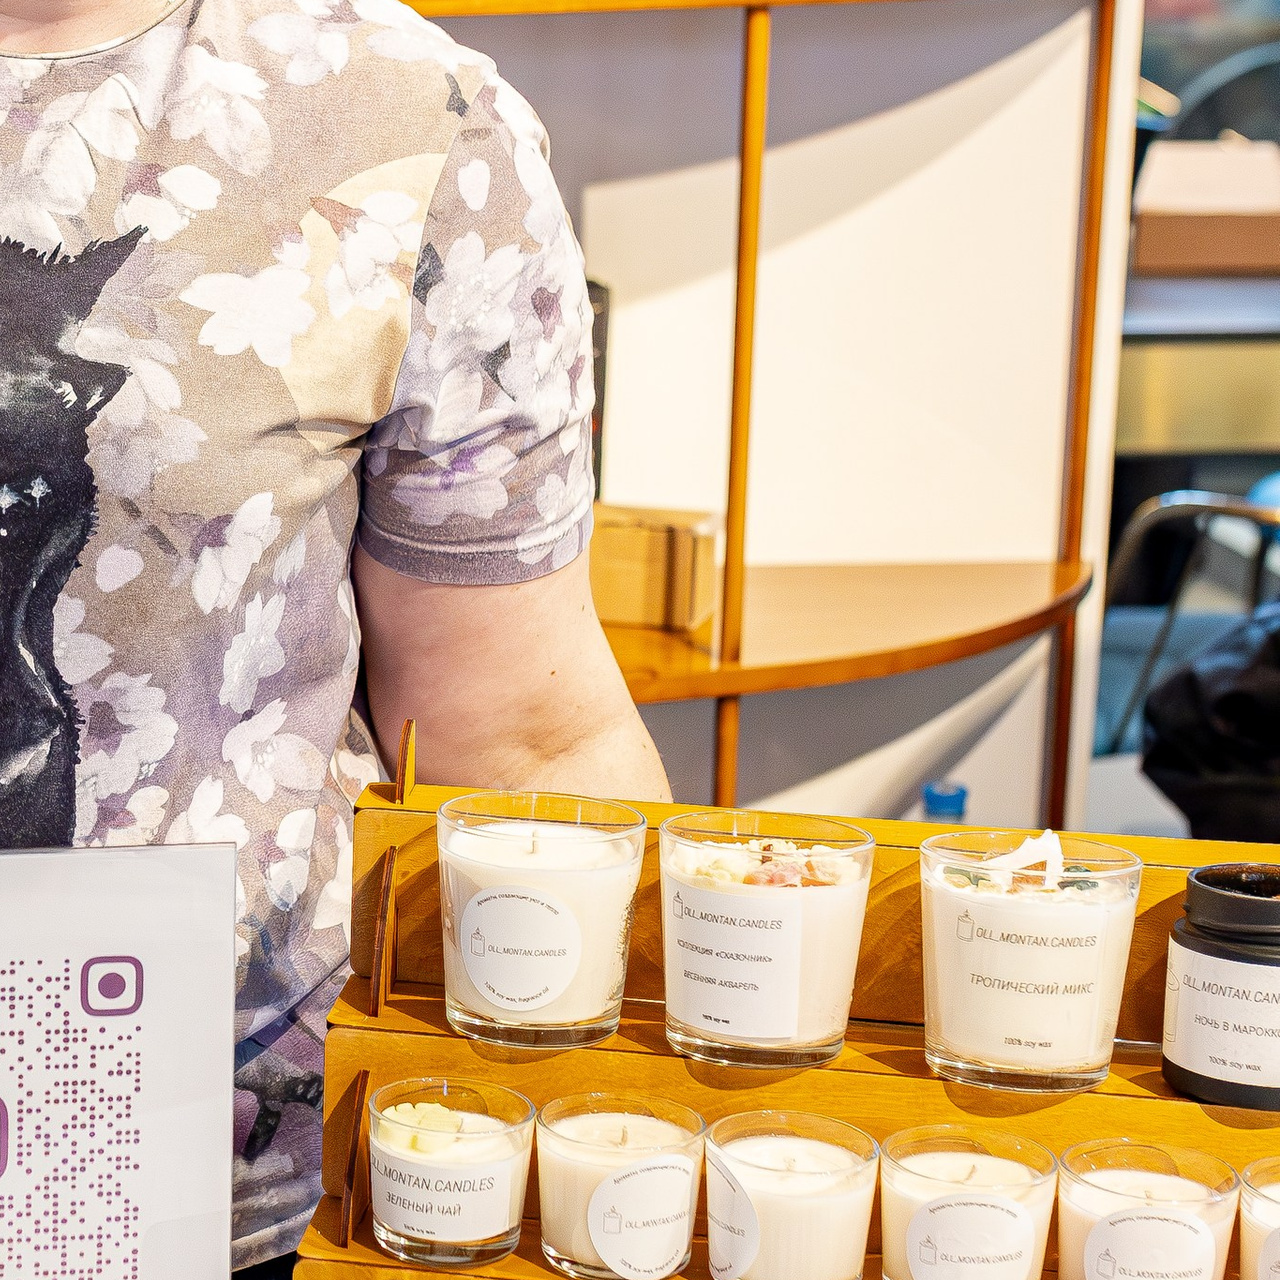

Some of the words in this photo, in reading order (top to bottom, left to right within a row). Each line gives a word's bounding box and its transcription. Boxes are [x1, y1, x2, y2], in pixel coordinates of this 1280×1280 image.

[684, 906, 782, 930] OLL_MONTAN.CANDLES
[976, 927, 1097, 948] OLL_MONTAN.CANDLES
[487, 944, 568, 958] OLL_MONTAN.CANDLES
[970, 972, 1059, 995] ТРОПИЧЕСКИЙ
[1062, 982, 1095, 995] МИКС
[1195, 1014, 1220, 1029] НОЧЬ
[1223, 1021, 1229, 1032] В
[1209, 1055, 1227, 1067] 100%
[1230, 1060, 1244, 1070] soy
[1245, 1063, 1261, 1072] wax
[386, 1191, 433, 1215] ЗЕЛЕНЫЙ
[437, 1203, 461, 1216] ЧАЙ
